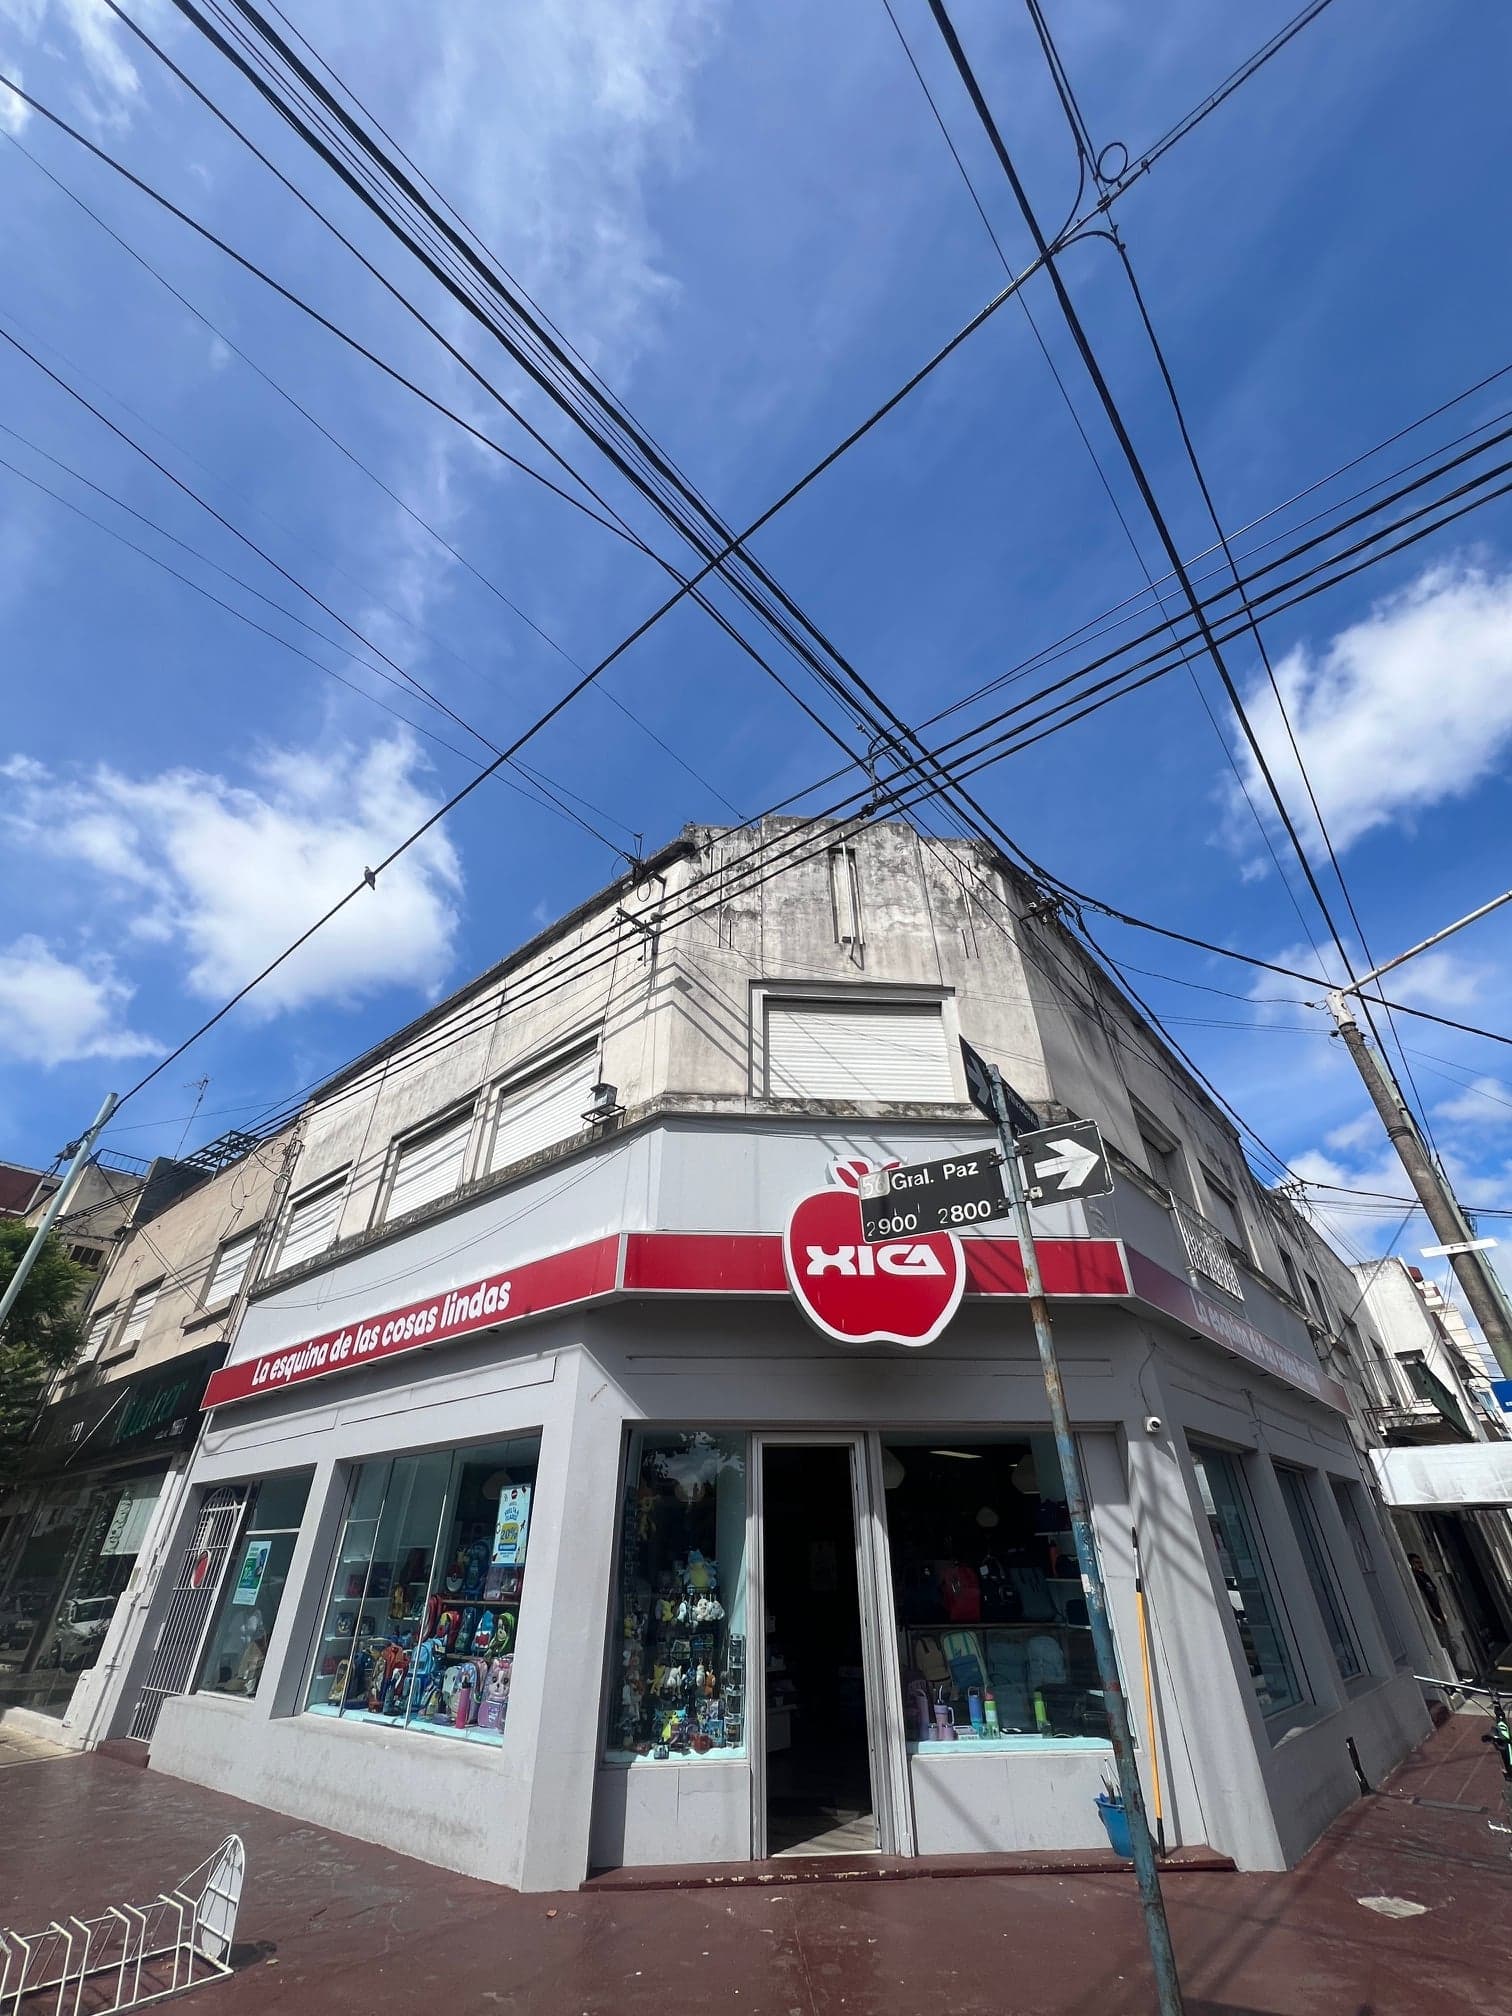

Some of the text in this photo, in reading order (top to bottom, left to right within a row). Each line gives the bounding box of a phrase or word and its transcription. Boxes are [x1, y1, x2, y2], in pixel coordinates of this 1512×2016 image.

[891, 1162, 979, 1190] Gral. Paz
[866, 1200, 991, 1237] 2900 2800
[252, 1281, 511, 1386] La esquina de las cosas lindas
